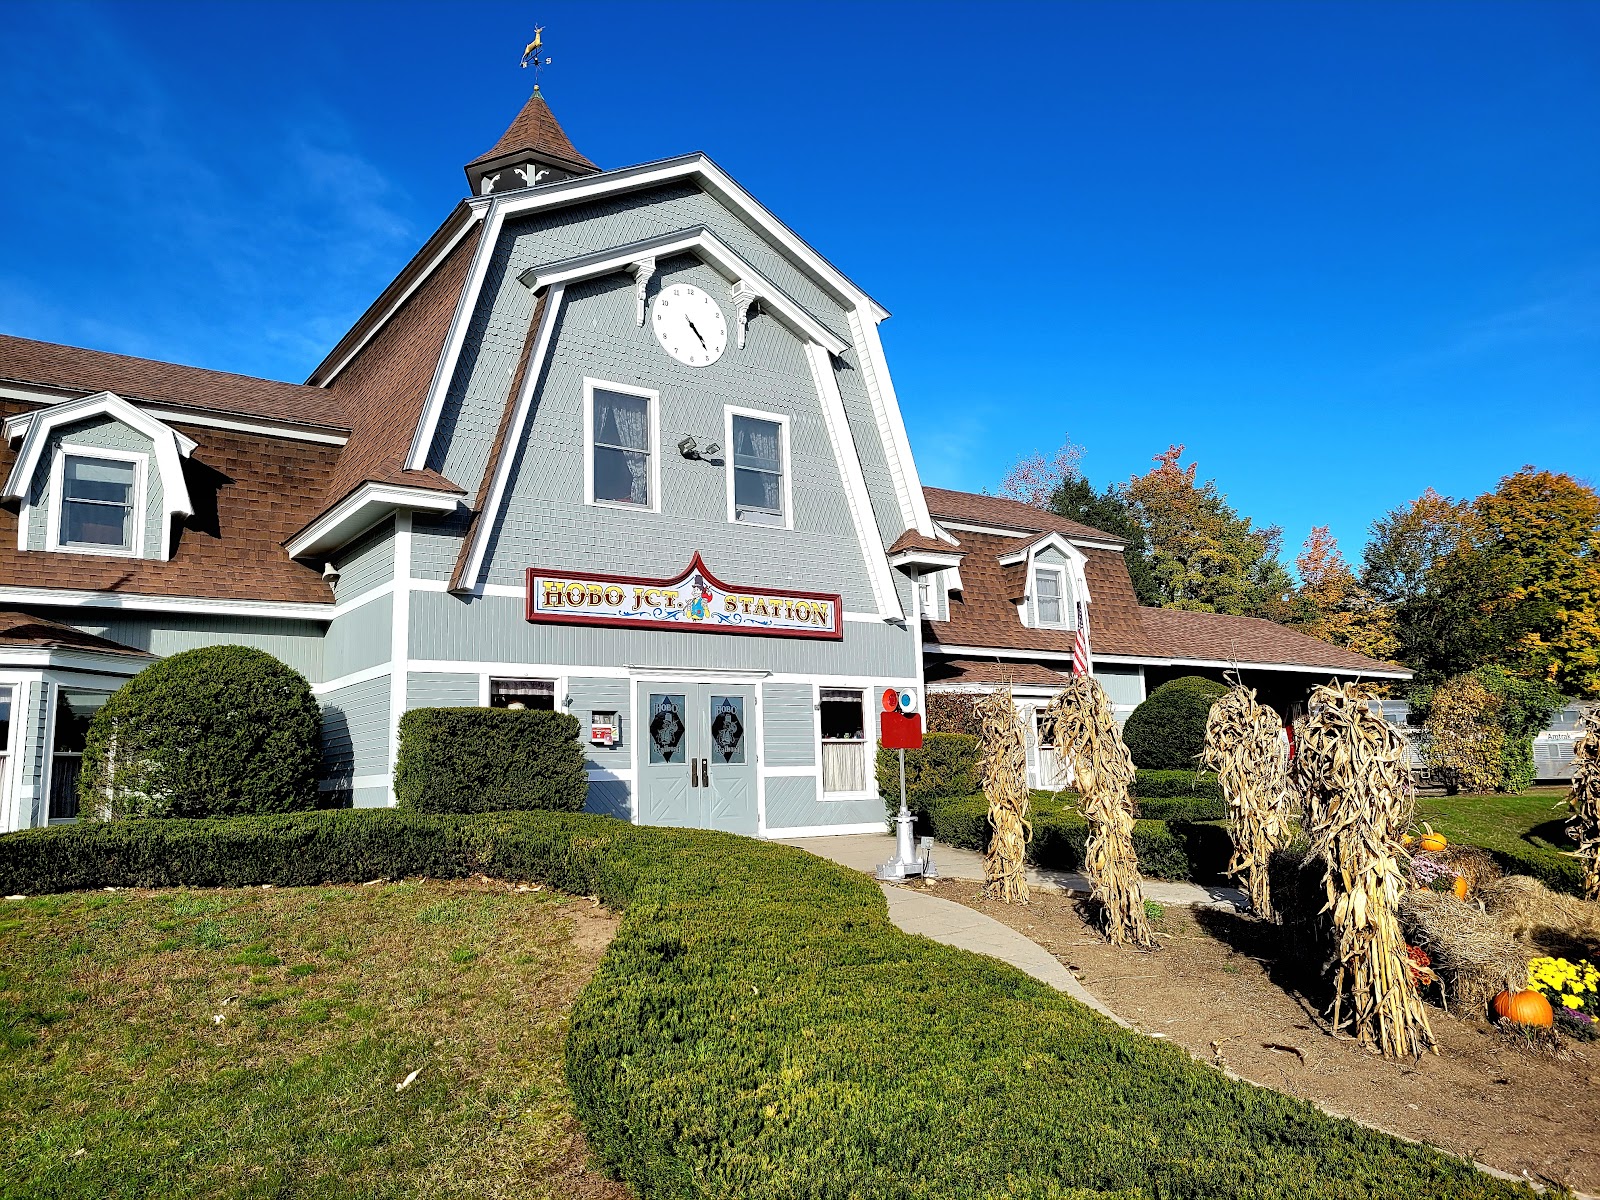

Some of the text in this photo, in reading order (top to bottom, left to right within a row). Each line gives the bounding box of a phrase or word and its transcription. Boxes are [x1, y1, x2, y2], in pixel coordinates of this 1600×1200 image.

[673, 289, 680, 297] 11
[687, 288, 695, 296] 12
[661, 299, 669, 307] 10
[662, 332, 668, 340] 8
[689, 355, 695, 363] 6
[542, 580, 829, 627] HOBO JCT. STATION
[654, 702, 680, 715] HOBO
[715, 704, 738, 716] HOBO
[1547, 732, 1572, 740] Amtrak
